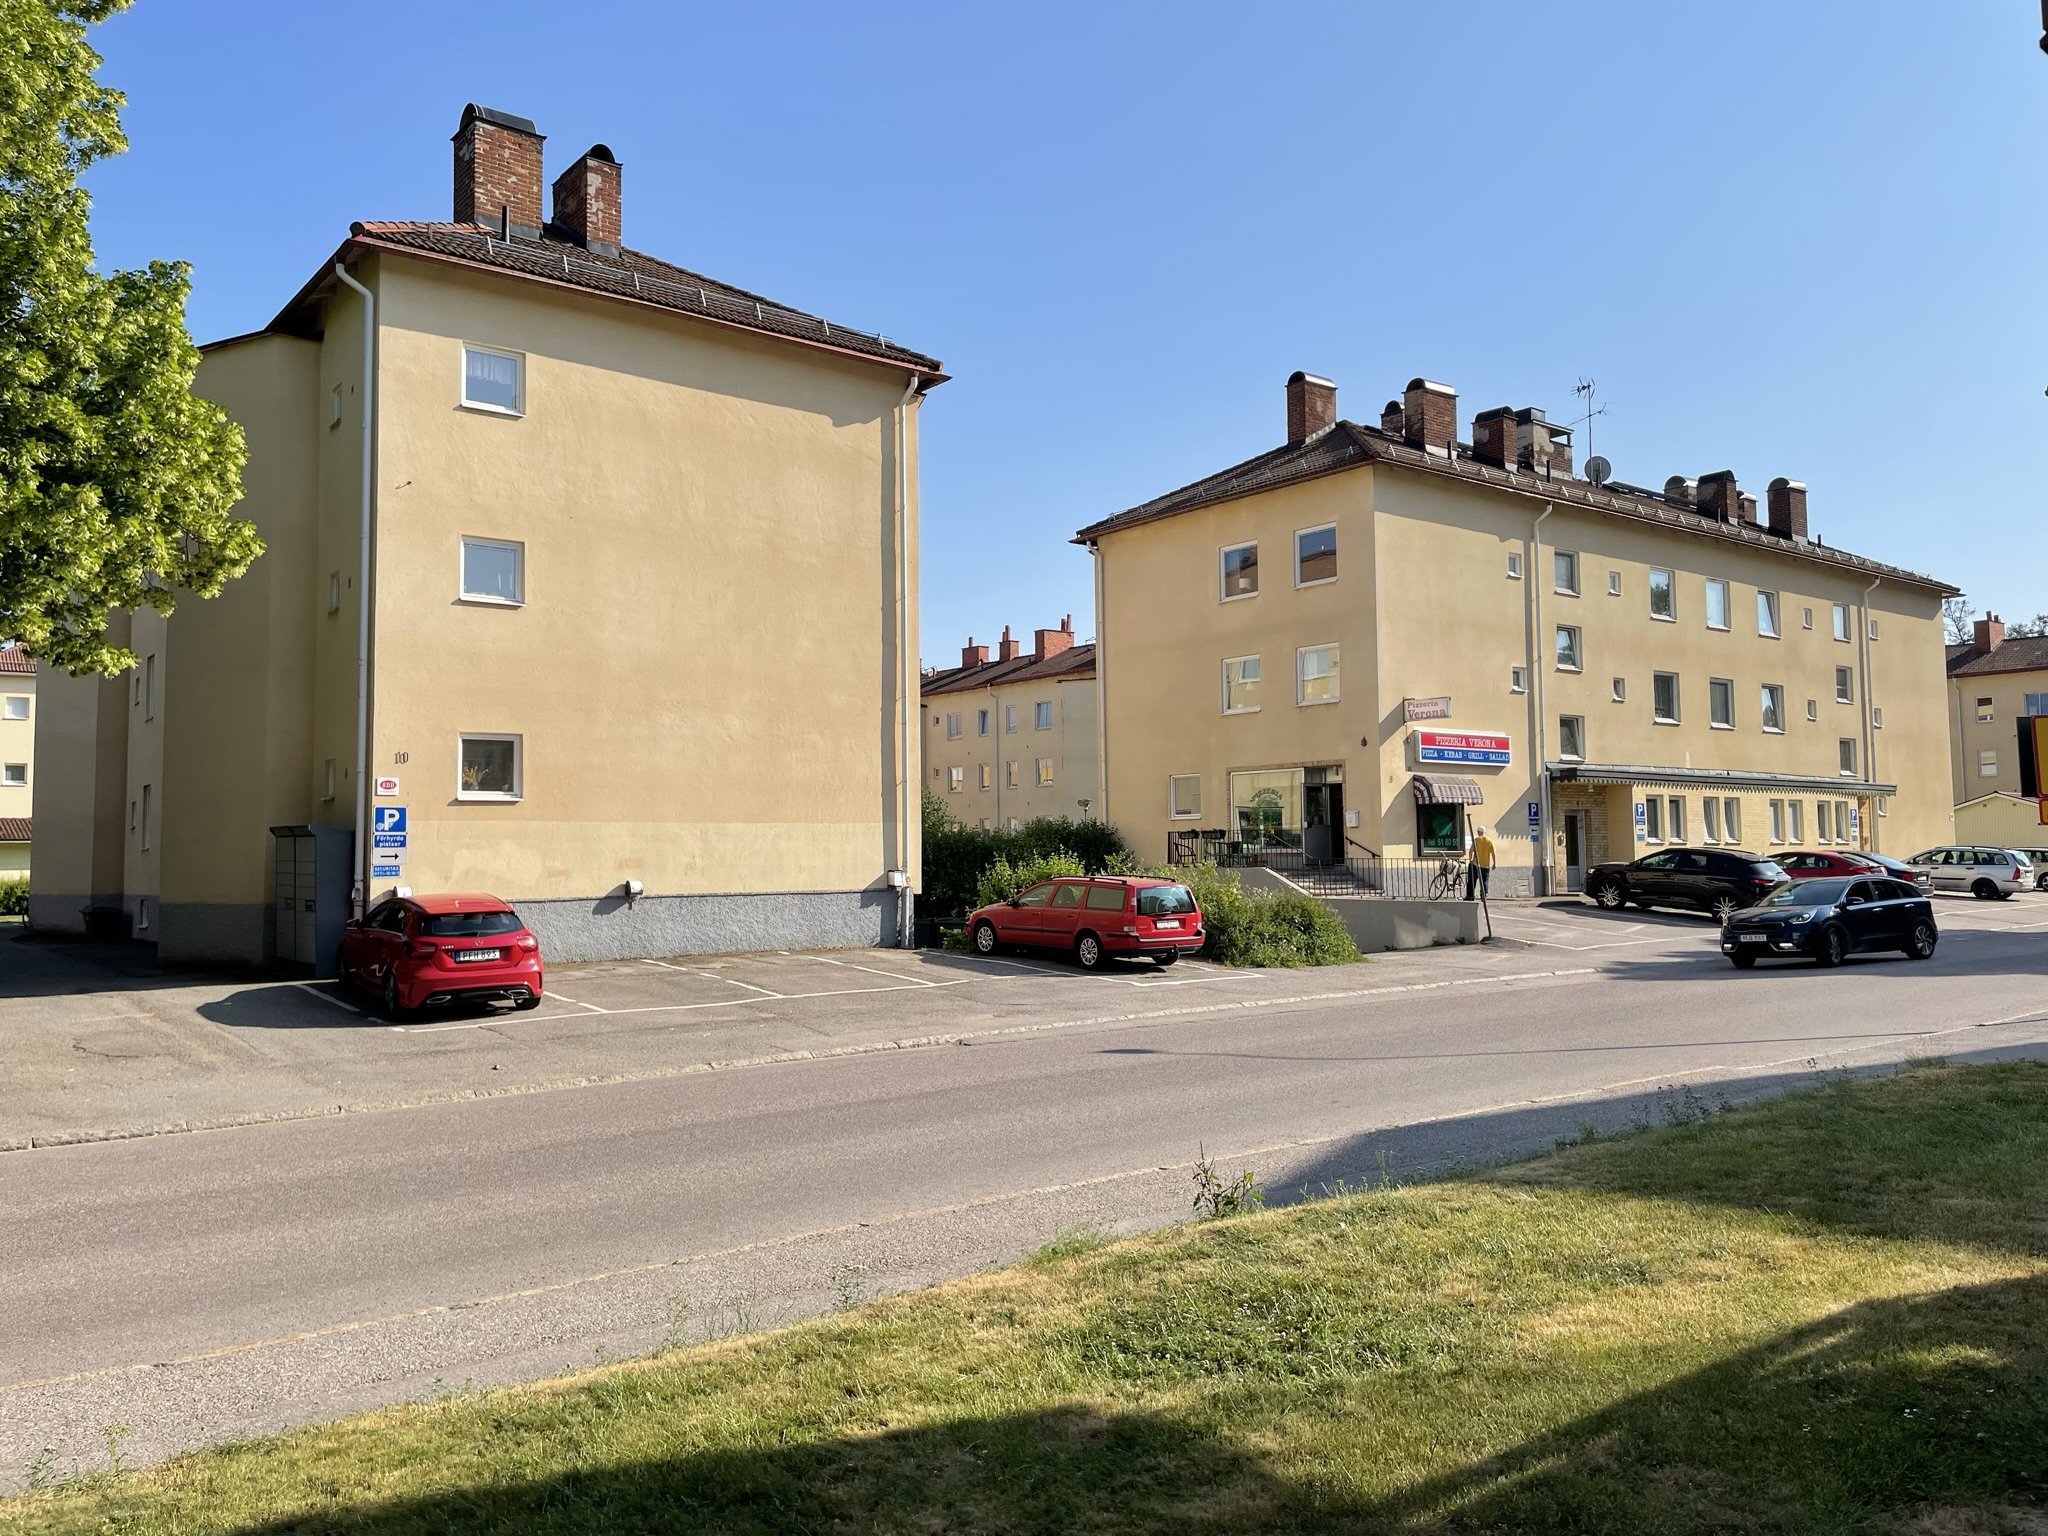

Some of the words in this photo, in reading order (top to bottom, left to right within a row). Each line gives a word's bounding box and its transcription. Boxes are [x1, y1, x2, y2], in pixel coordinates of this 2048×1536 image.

[1407, 701, 1439, 709] Pizzeria
[1407, 709, 1447, 719] Verona
[1435, 736, 1467, 746] PIZZERIA
[1469, 738, 1497, 748] VERONA
[394, 751, 409, 765] 10
[1422, 749, 1438, 758] PIZZA
[1444, 751, 1463, 759] KEBAB
[1468, 752, 1485, 760] GRILL
[1489, 753, 1509, 761] SALLAD
[1531, 804, 1537, 816] P
[1638, 804, 1643, 816] P
[384, 809, 400, 831] P
[463, 951, 479, 959] PFH
